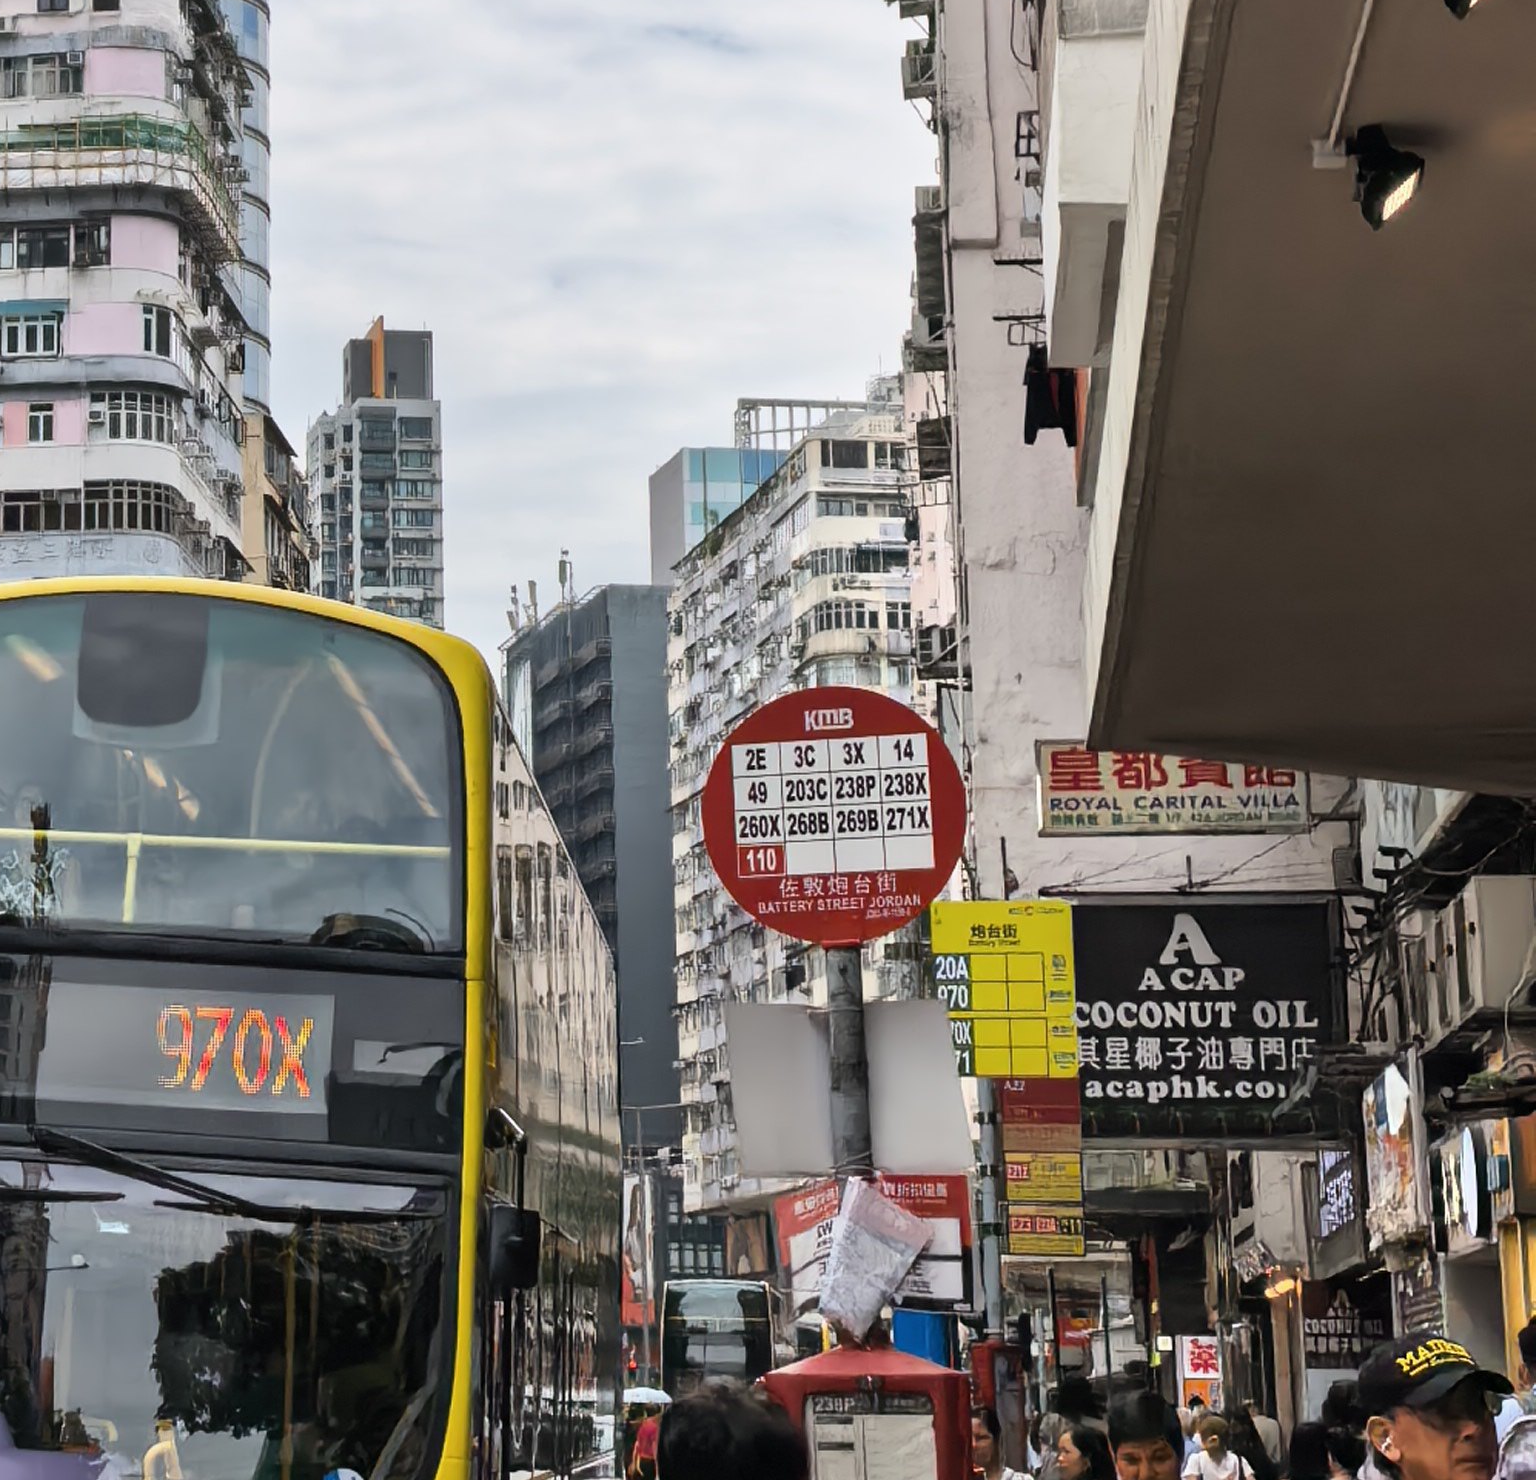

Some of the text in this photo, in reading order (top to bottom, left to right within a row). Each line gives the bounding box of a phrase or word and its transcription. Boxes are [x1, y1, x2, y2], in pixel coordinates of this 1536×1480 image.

[804, 707, 854, 731] KMB
[745, 739, 915, 771] 2E 3C 3X 14
[747, 772, 927, 804] 49 203C 238P 238X
[1050, 797, 1122, 812] ROYAL
[1235, 793, 1300, 810] VILLA
[738, 805, 930, 838] 260X 268B 269B 271X
[746, 848, 777, 872] 110
[779, 873, 898, 897] 佐敦炮台街
[758, 893, 922, 915] BATTERY STREET JORDAN
[970, 924, 1017, 939] 炮台街
[1158, 912, 1223, 966] A
[935, 956, 969, 980] 20A
[1138, 967, 1247, 992] A CAP
[1075, 999, 1318, 1029] COCONUT OIL
[156, 1003, 315, 1098] 970X
